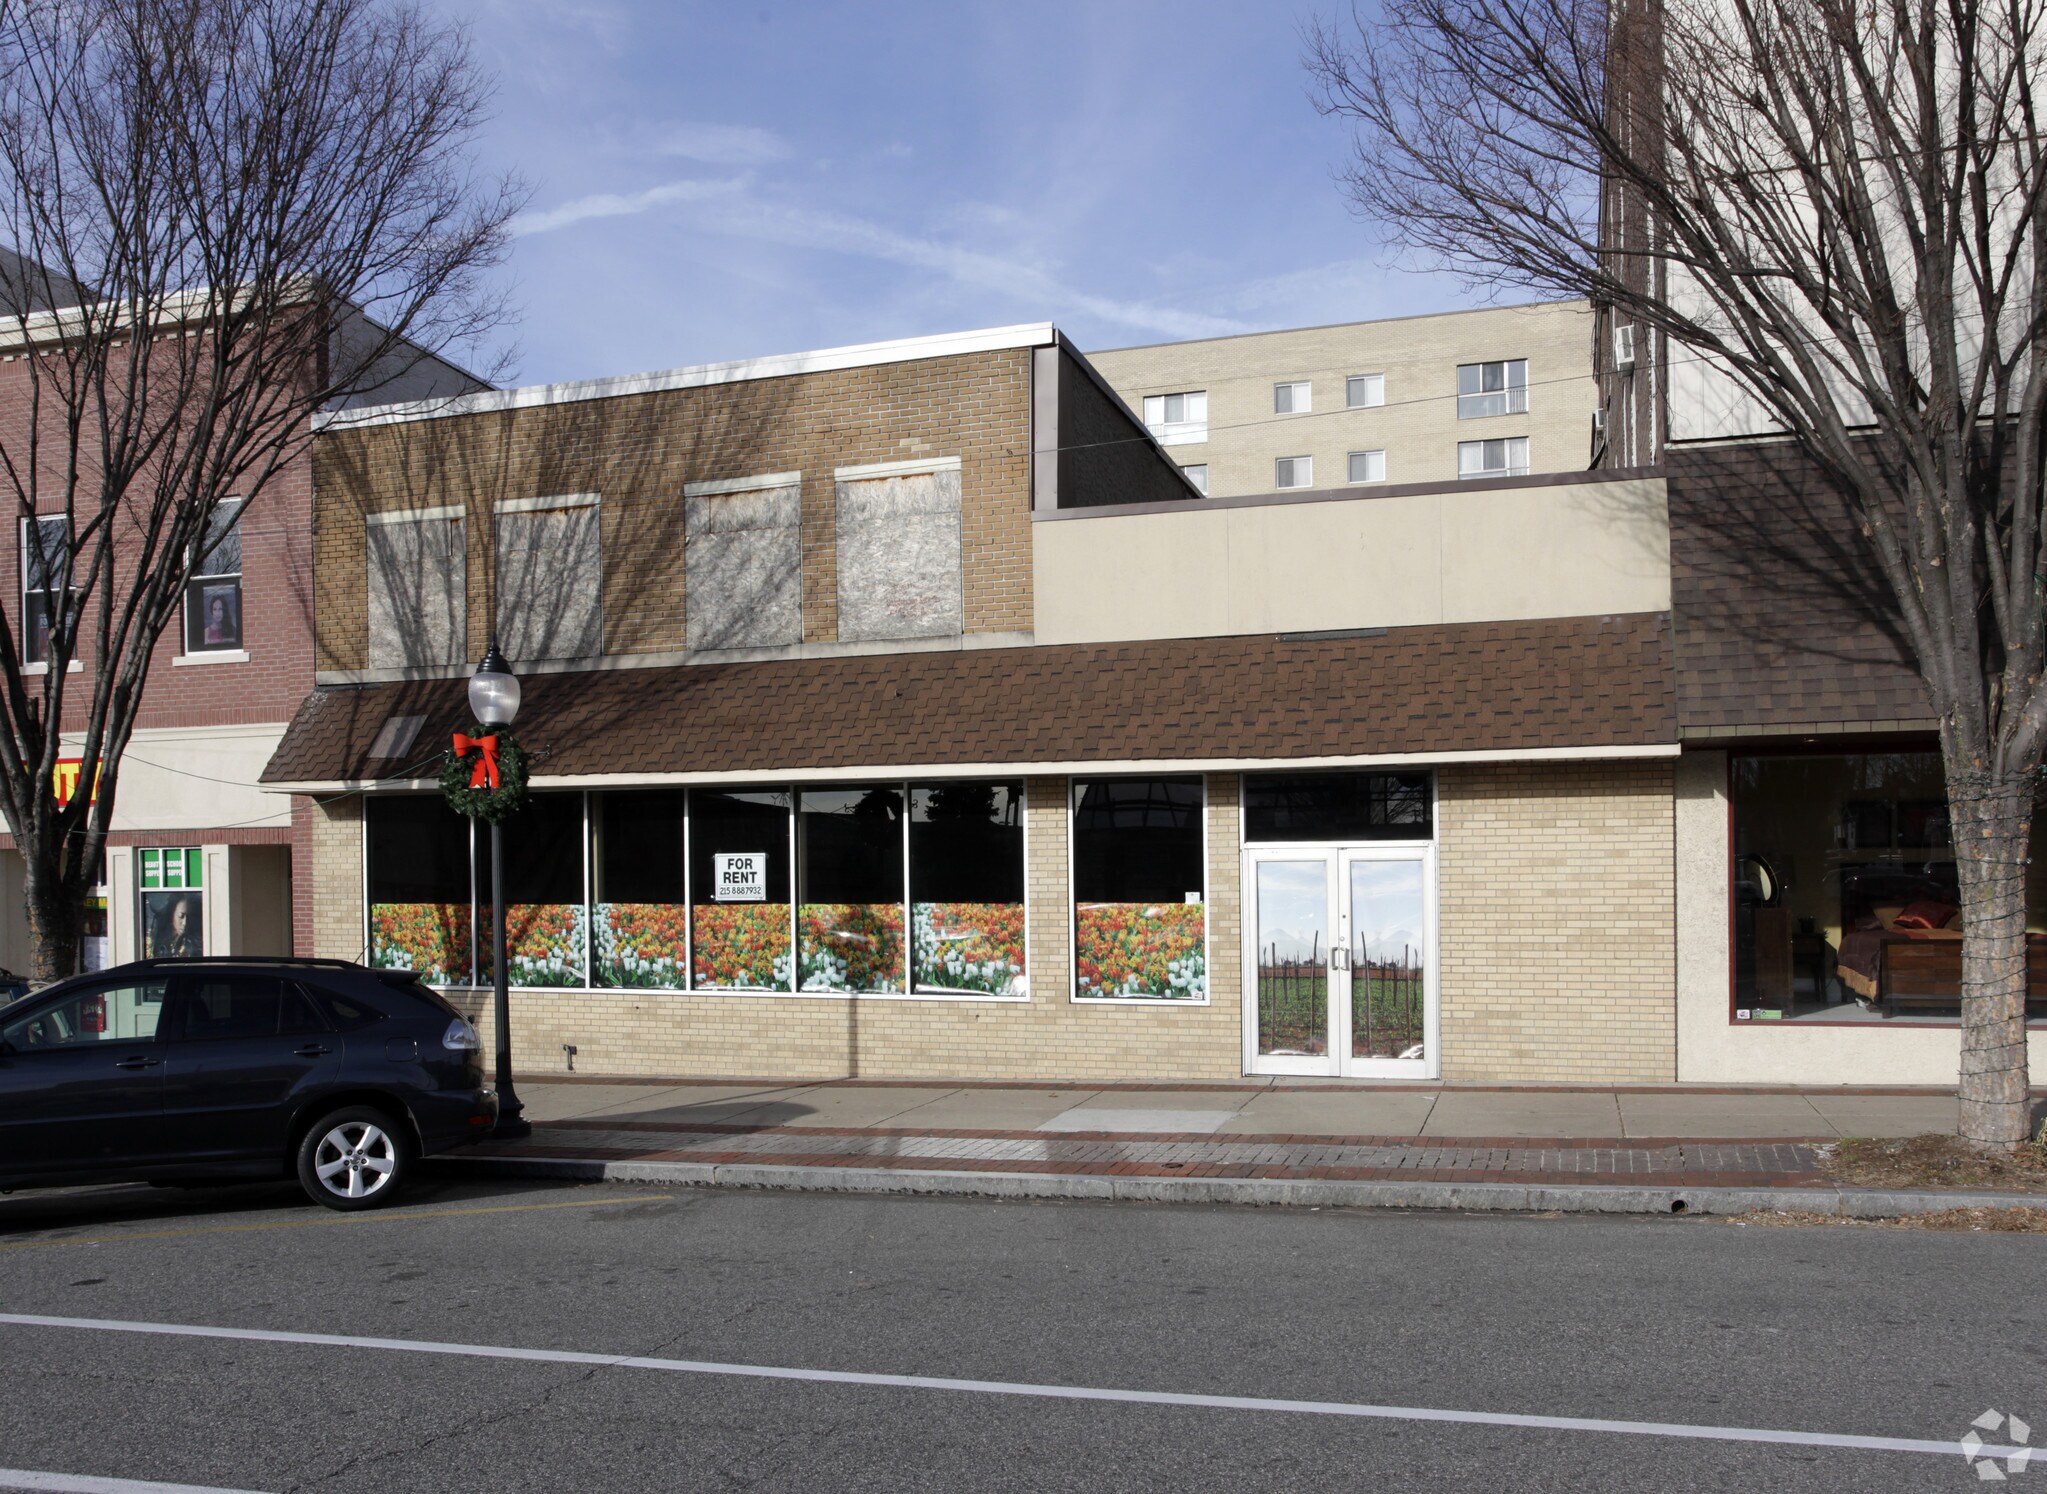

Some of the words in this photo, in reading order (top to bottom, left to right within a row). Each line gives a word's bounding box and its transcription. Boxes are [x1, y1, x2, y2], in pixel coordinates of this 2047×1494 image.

[727, 858, 753, 870] FOR
[145, 869, 160, 877] SUPPL
[723, 871, 758, 884] RENT
[719, 886, 731, 895] 215
[732, 886, 761, 895] 8887932
